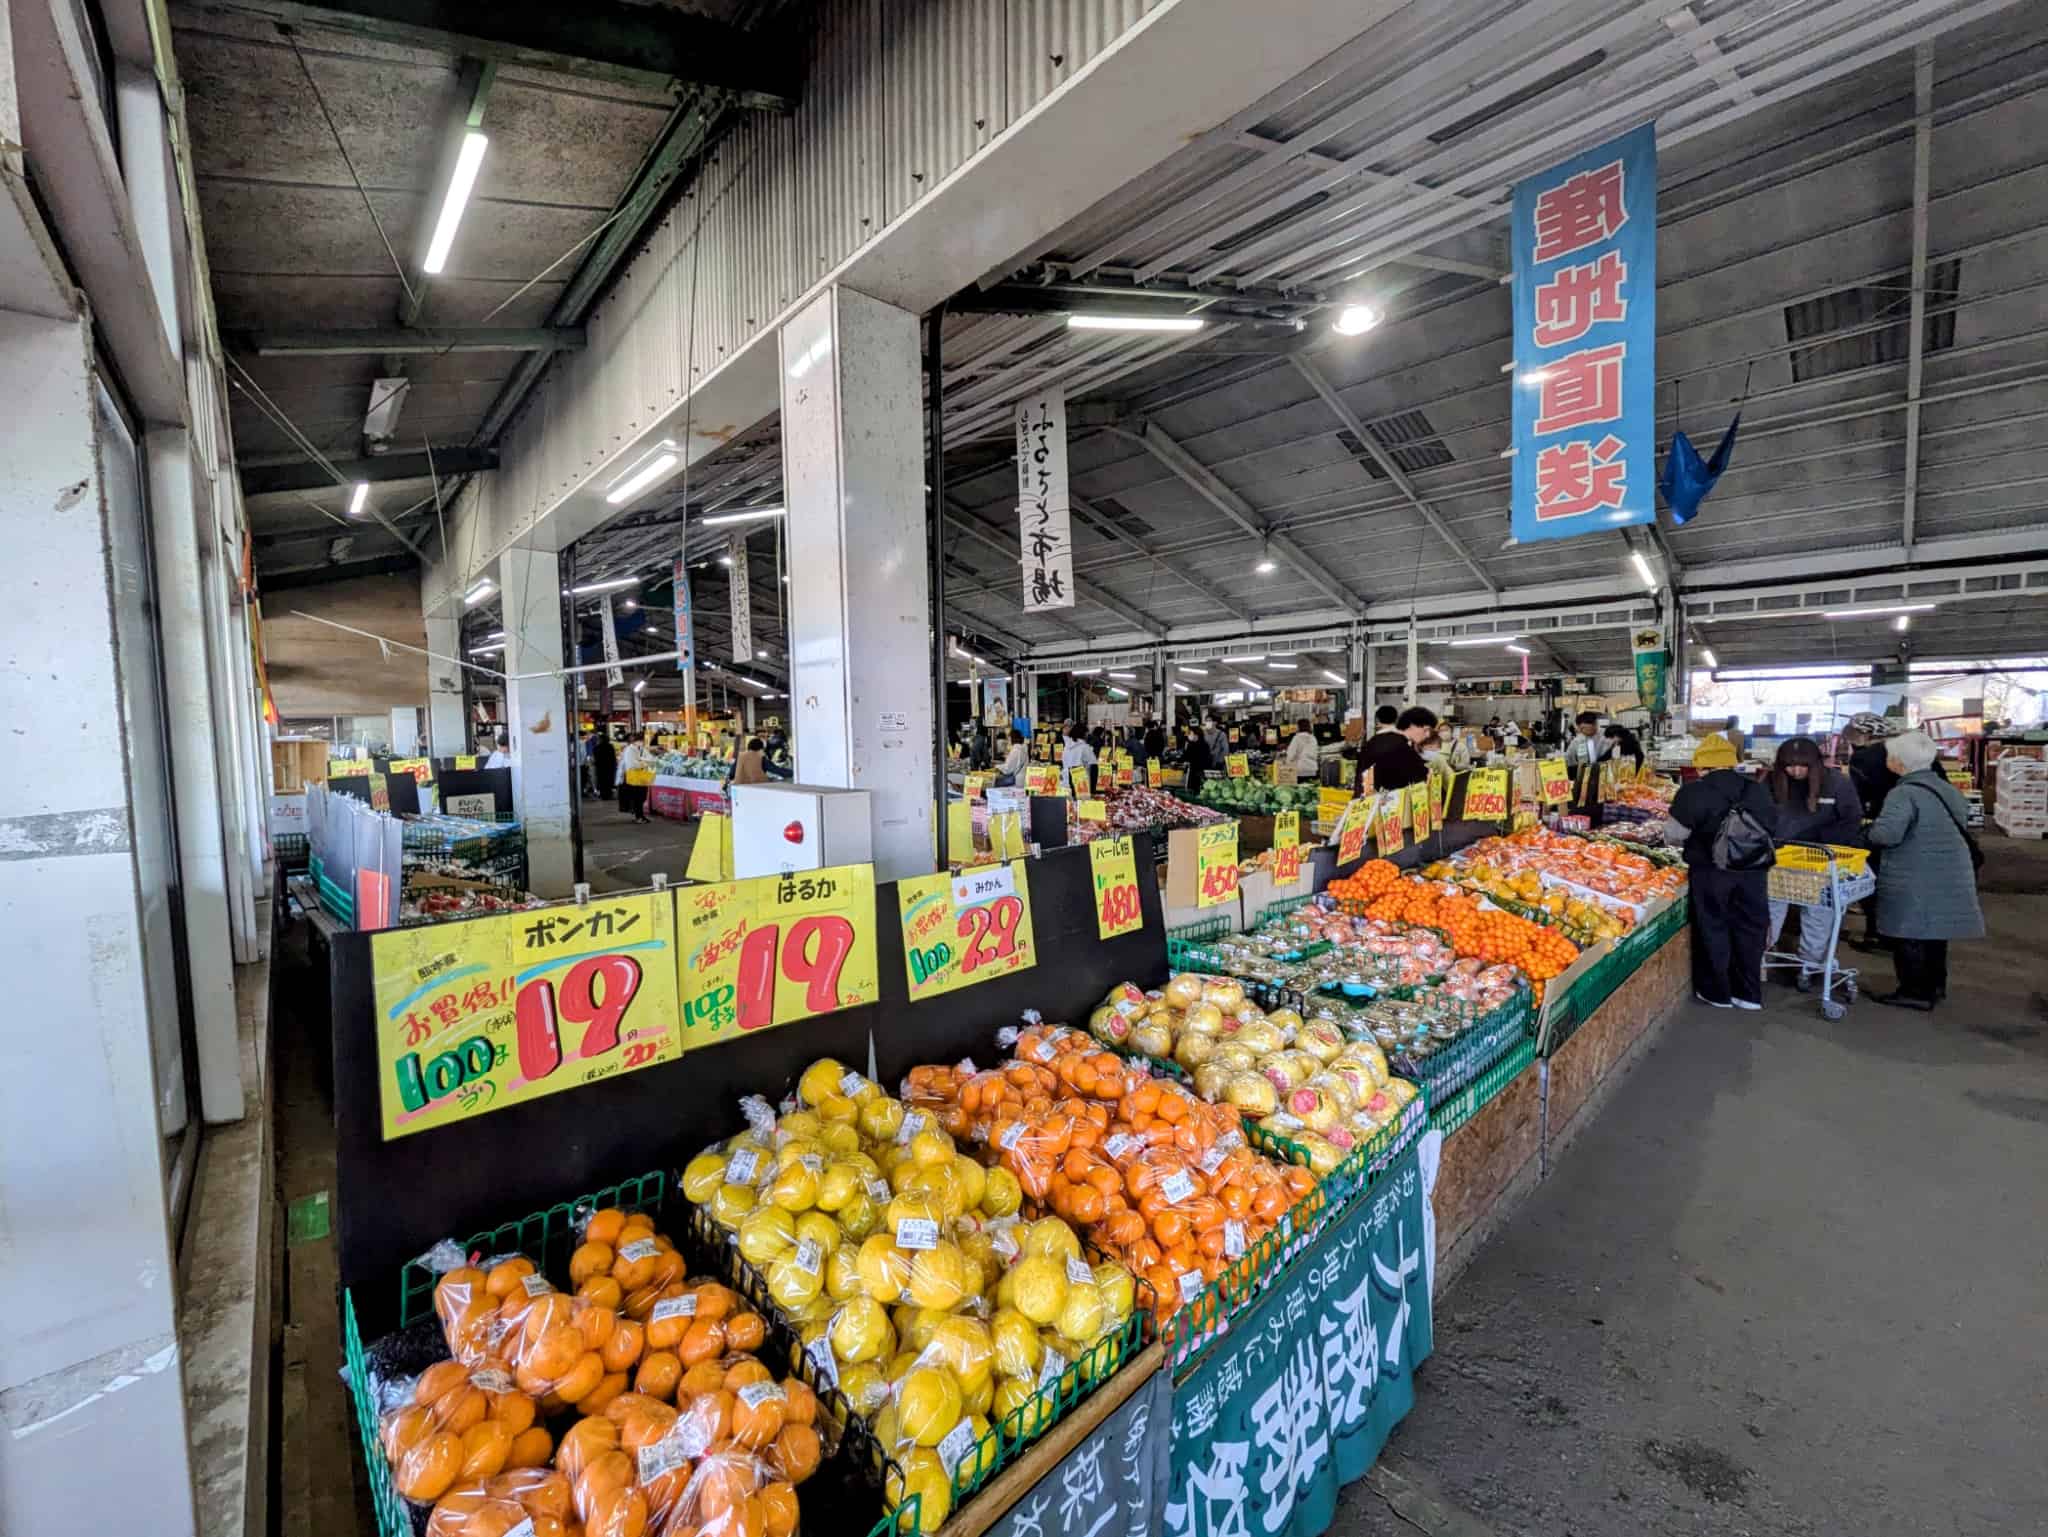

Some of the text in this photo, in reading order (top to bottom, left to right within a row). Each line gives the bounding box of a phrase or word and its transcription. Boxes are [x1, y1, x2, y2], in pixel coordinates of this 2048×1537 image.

[778, 877, 837, 905] はるか
[975, 878, 1003, 894] みかん
[1203, 864, 1240, 897] 450
[1102, 884, 1141, 931] 480
[524, 908, 641, 949] ポンカン
[957, 895, 1025, 975] 29
[737, 914, 856, 1030] 19
[516, 954, 644, 1082] 19 円
[623, 1042, 657, 1069] 20
